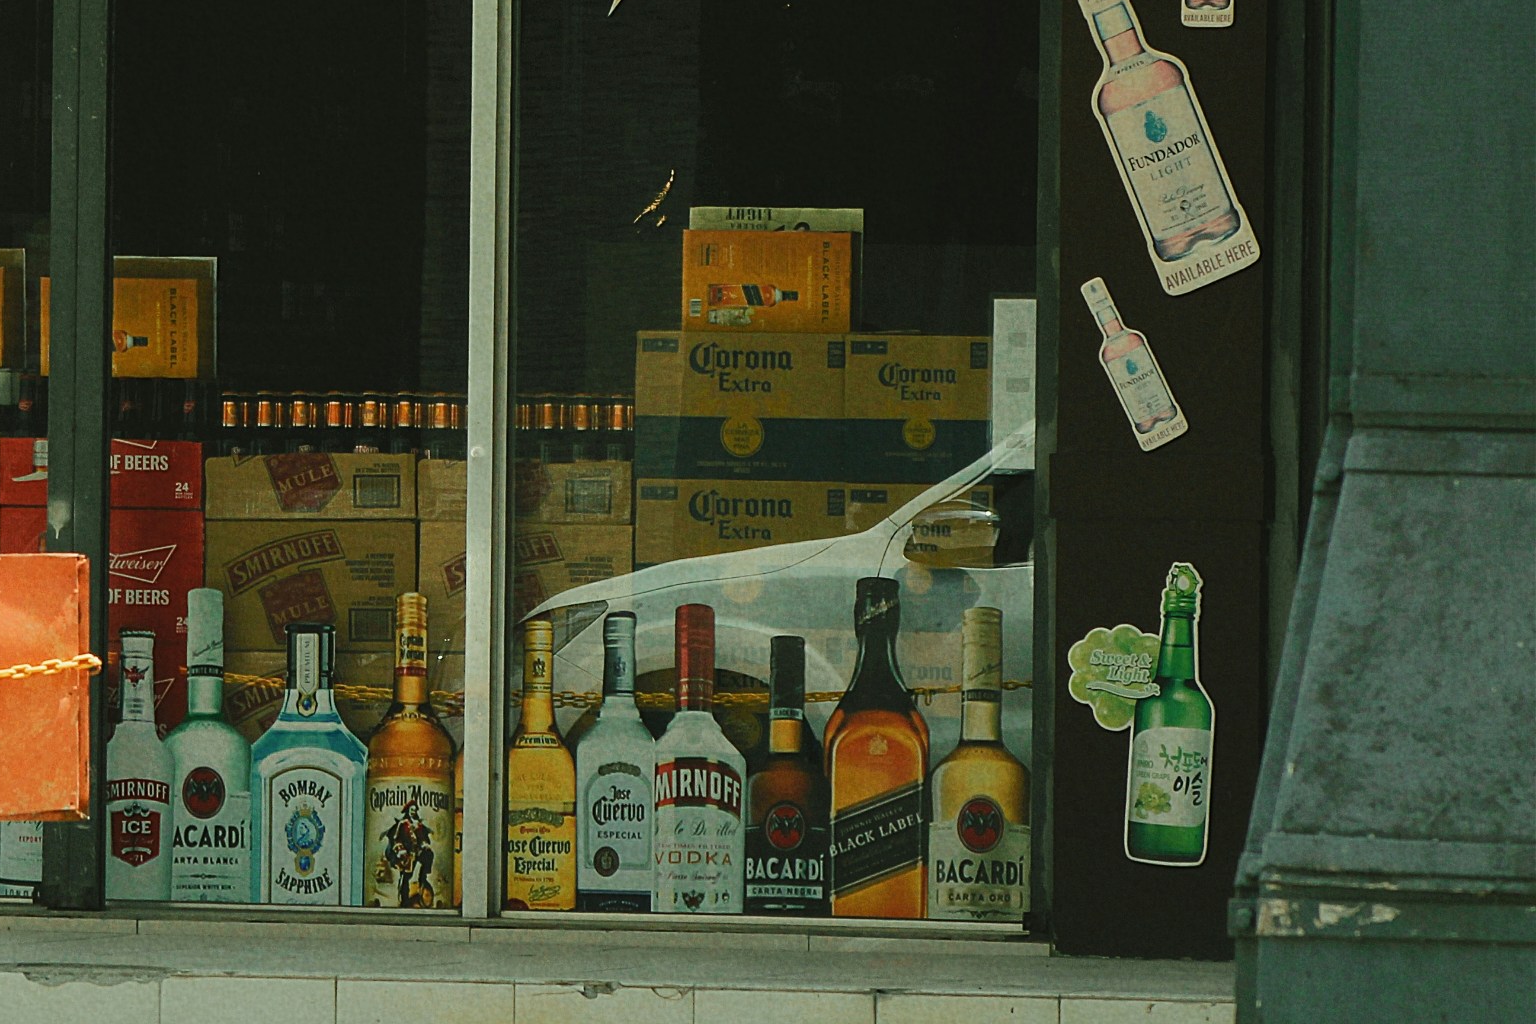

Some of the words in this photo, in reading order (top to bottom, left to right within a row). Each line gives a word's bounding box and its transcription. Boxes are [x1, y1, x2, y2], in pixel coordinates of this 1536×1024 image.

[1184, 14, 1214, 23] AVAILABLE
[1215, 14, 1232, 23] HERE
[1127, 132, 1201, 173] FUNDADOR
[1150, 156, 1193, 182] LIGHT
[822, 241, 831, 281] BLACK
[1165, 254, 1225, 291] AVAILABLE
[1226, 239, 1256, 266] HERE
[169, 288, 177, 326] BLACK
[821, 284, 830, 323] LABEL
[169, 330, 177, 369] LABEL
[690, 342, 794, 378] Corona
[718, 372, 772, 393] Extra
[878, 362, 958, 390] Corona
[1119, 368, 1156, 390] FUNDADOR
[900, 385, 942, 401] Extra
[1141, 427, 1173, 448] AVAILABLE
[1172, 419, 1187, 435] HERE
[124, 455, 169, 471] BEERS
[175, 482, 189, 492] 24
[277, 463, 334, 494] MULE
[688, 489, 793, 526] Corona
[718, 519, 772, 541] Extra
[912, 523, 952, 537] rona
[109, 555, 164, 570] dweiser
[233, 533, 334, 585] SMIRNOFF
[125, 589, 170, 606] BEERS
[270, 595, 330, 626] MULE
[303, 638, 311, 685] PREMIUM
[1089, 649, 1138, 667] Sweet
[1138, 652, 1152, 669] &
[1106, 665, 1151, 686] Light
[517, 735, 558, 746] Premium
[278, 778, 332, 808] BOMBAY
[369, 785, 408, 812] Captain
[409, 785, 450, 812] Morgan
[611, 785, 632, 804] Jose
[655, 768, 741, 808] MIRNOFF
[591, 797, 645, 826] Cuervo
[121, 820, 152, 834] ICE
[172, 819, 246, 849] ACARDÍ
[597, 830, 643, 840] ESPECIAL
[829, 831, 875, 859] BLACK
[876, 813, 924, 840] LABEL
[508, 839, 527, 854] ose
[529, 836, 571, 857] Cuervo
[654, 850, 733, 866] VODKA
[173, 856, 199, 865] ARTA
[513, 856, 559, 876] Especial.
[746, 854, 825, 882] BACARDÍ
[935, 855, 1025, 885] BACARDÍ
[275, 867, 334, 895] SAPPHIRE
[752, 887, 783, 896] CARTA
[786, 887, 818, 897] NEGRA
[947, 891, 985, 903] CARTA
[988, 893, 1012, 904] ORO
